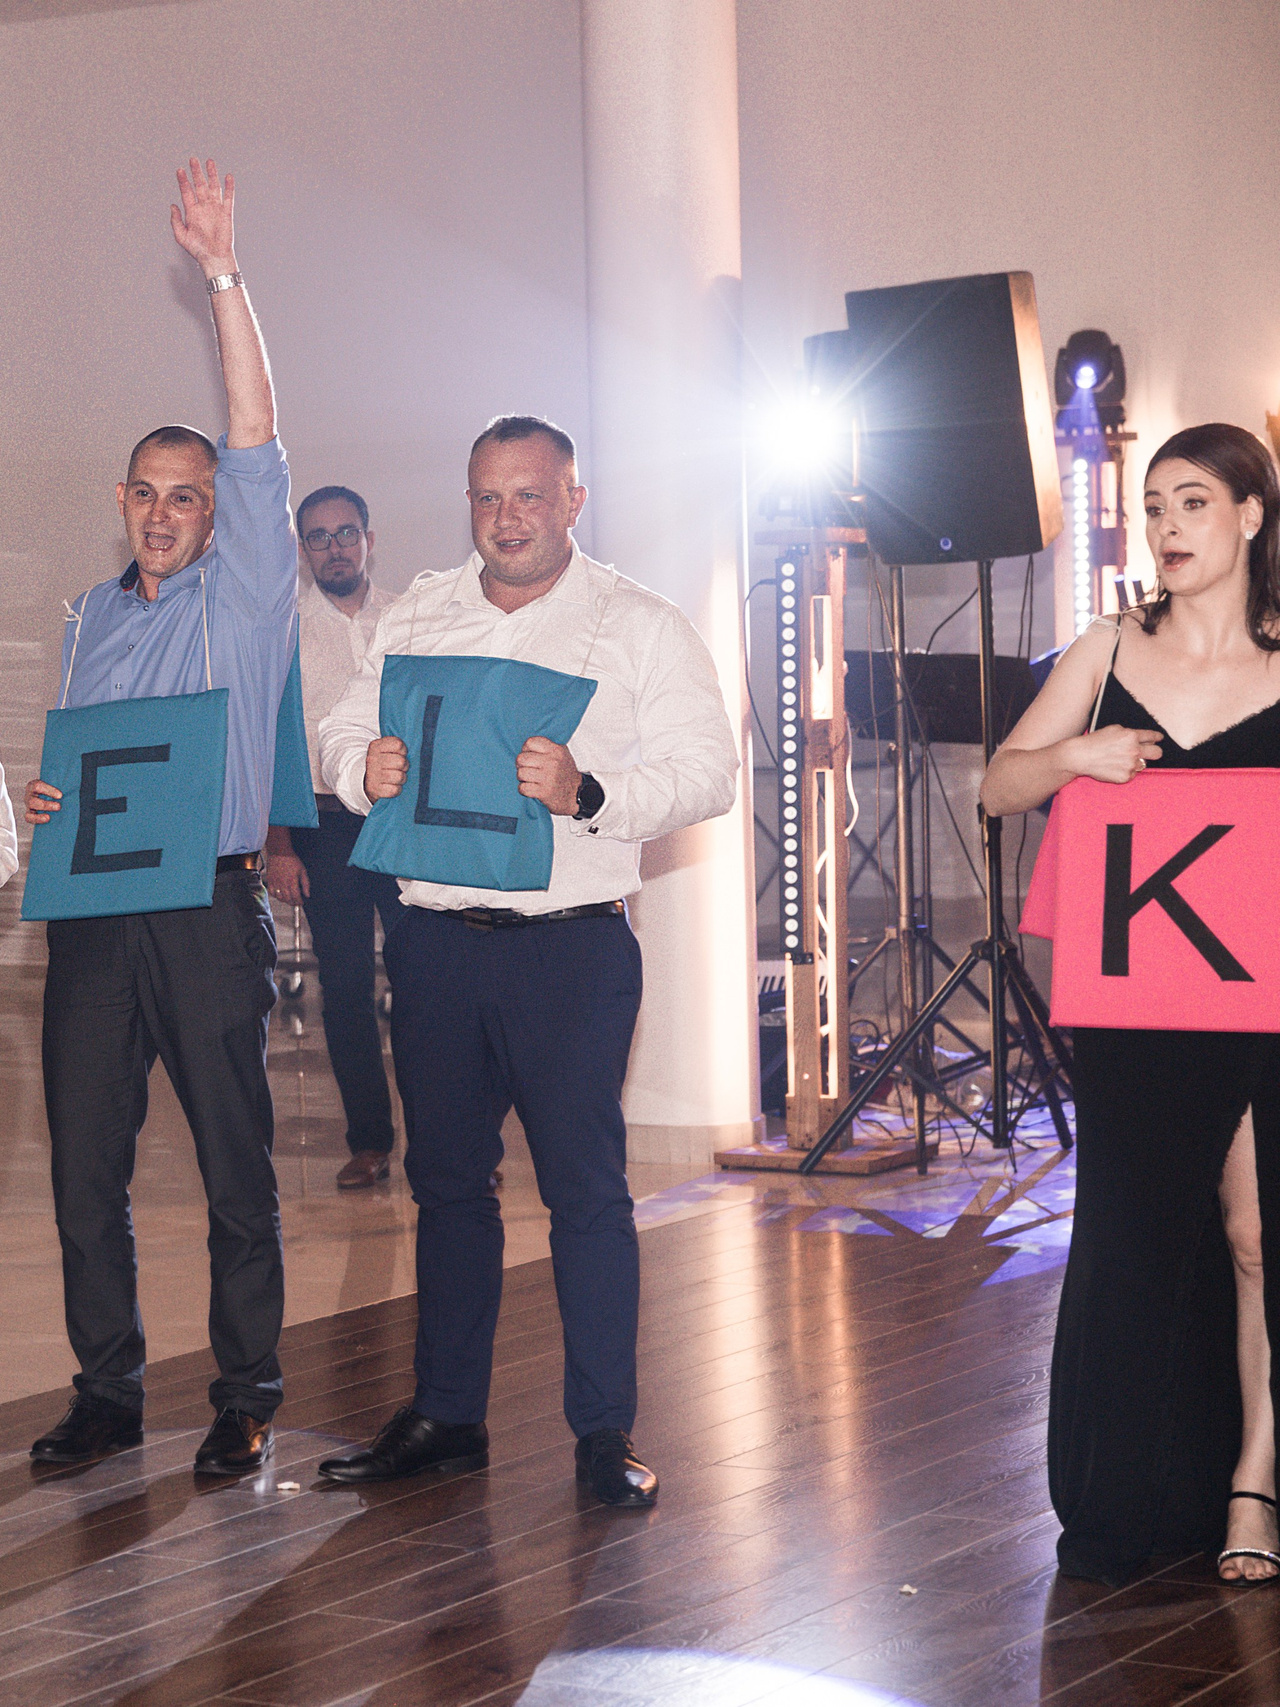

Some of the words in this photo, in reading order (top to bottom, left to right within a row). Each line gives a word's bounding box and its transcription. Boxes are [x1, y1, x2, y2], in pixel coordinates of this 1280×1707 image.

[70, 742, 171, 875] E
[414, 695, 518, 834] L
[1101, 823, 1256, 982] K
